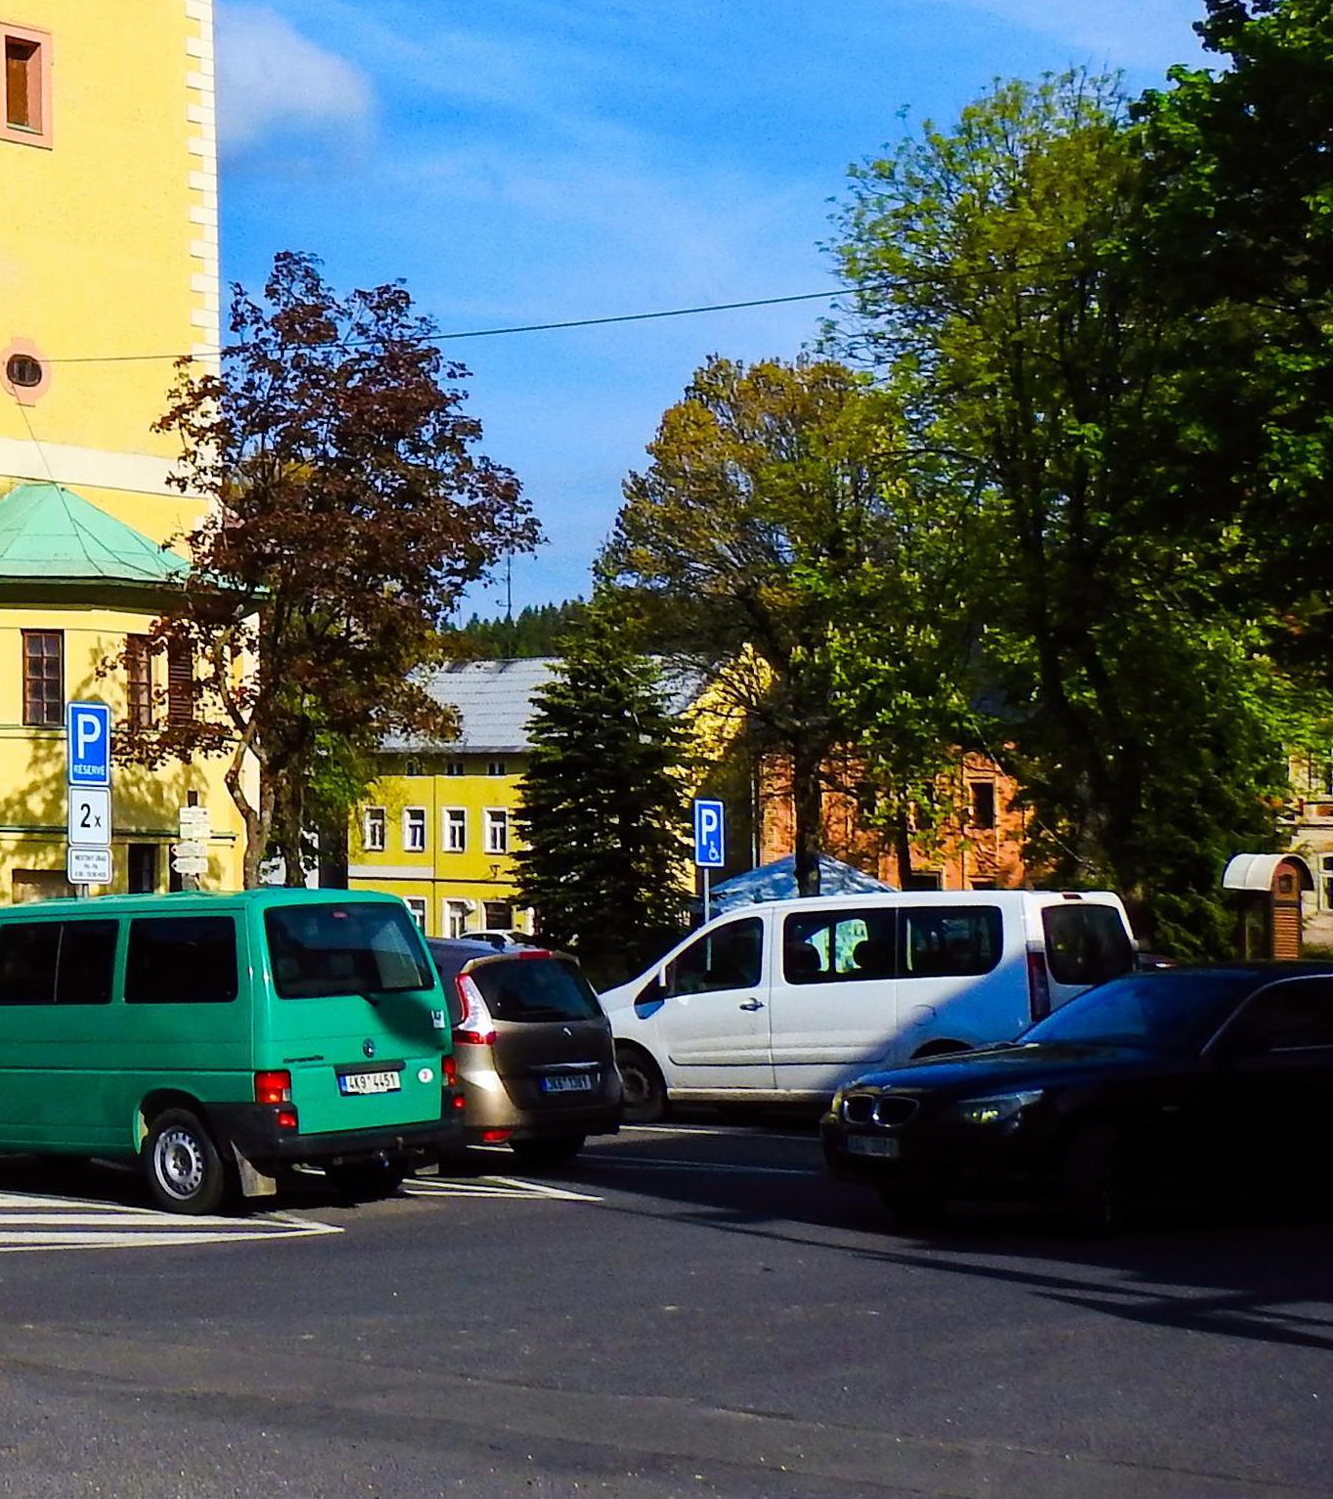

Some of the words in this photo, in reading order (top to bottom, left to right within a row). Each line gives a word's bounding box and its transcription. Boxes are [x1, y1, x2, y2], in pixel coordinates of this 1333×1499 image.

[78, 713, 101, 759] P
[80, 803, 91, 828] 2
[701, 809, 718, 845] P
[349, 1075, 367, 1089] 4K9
[374, 1073, 396, 1089] 4451
